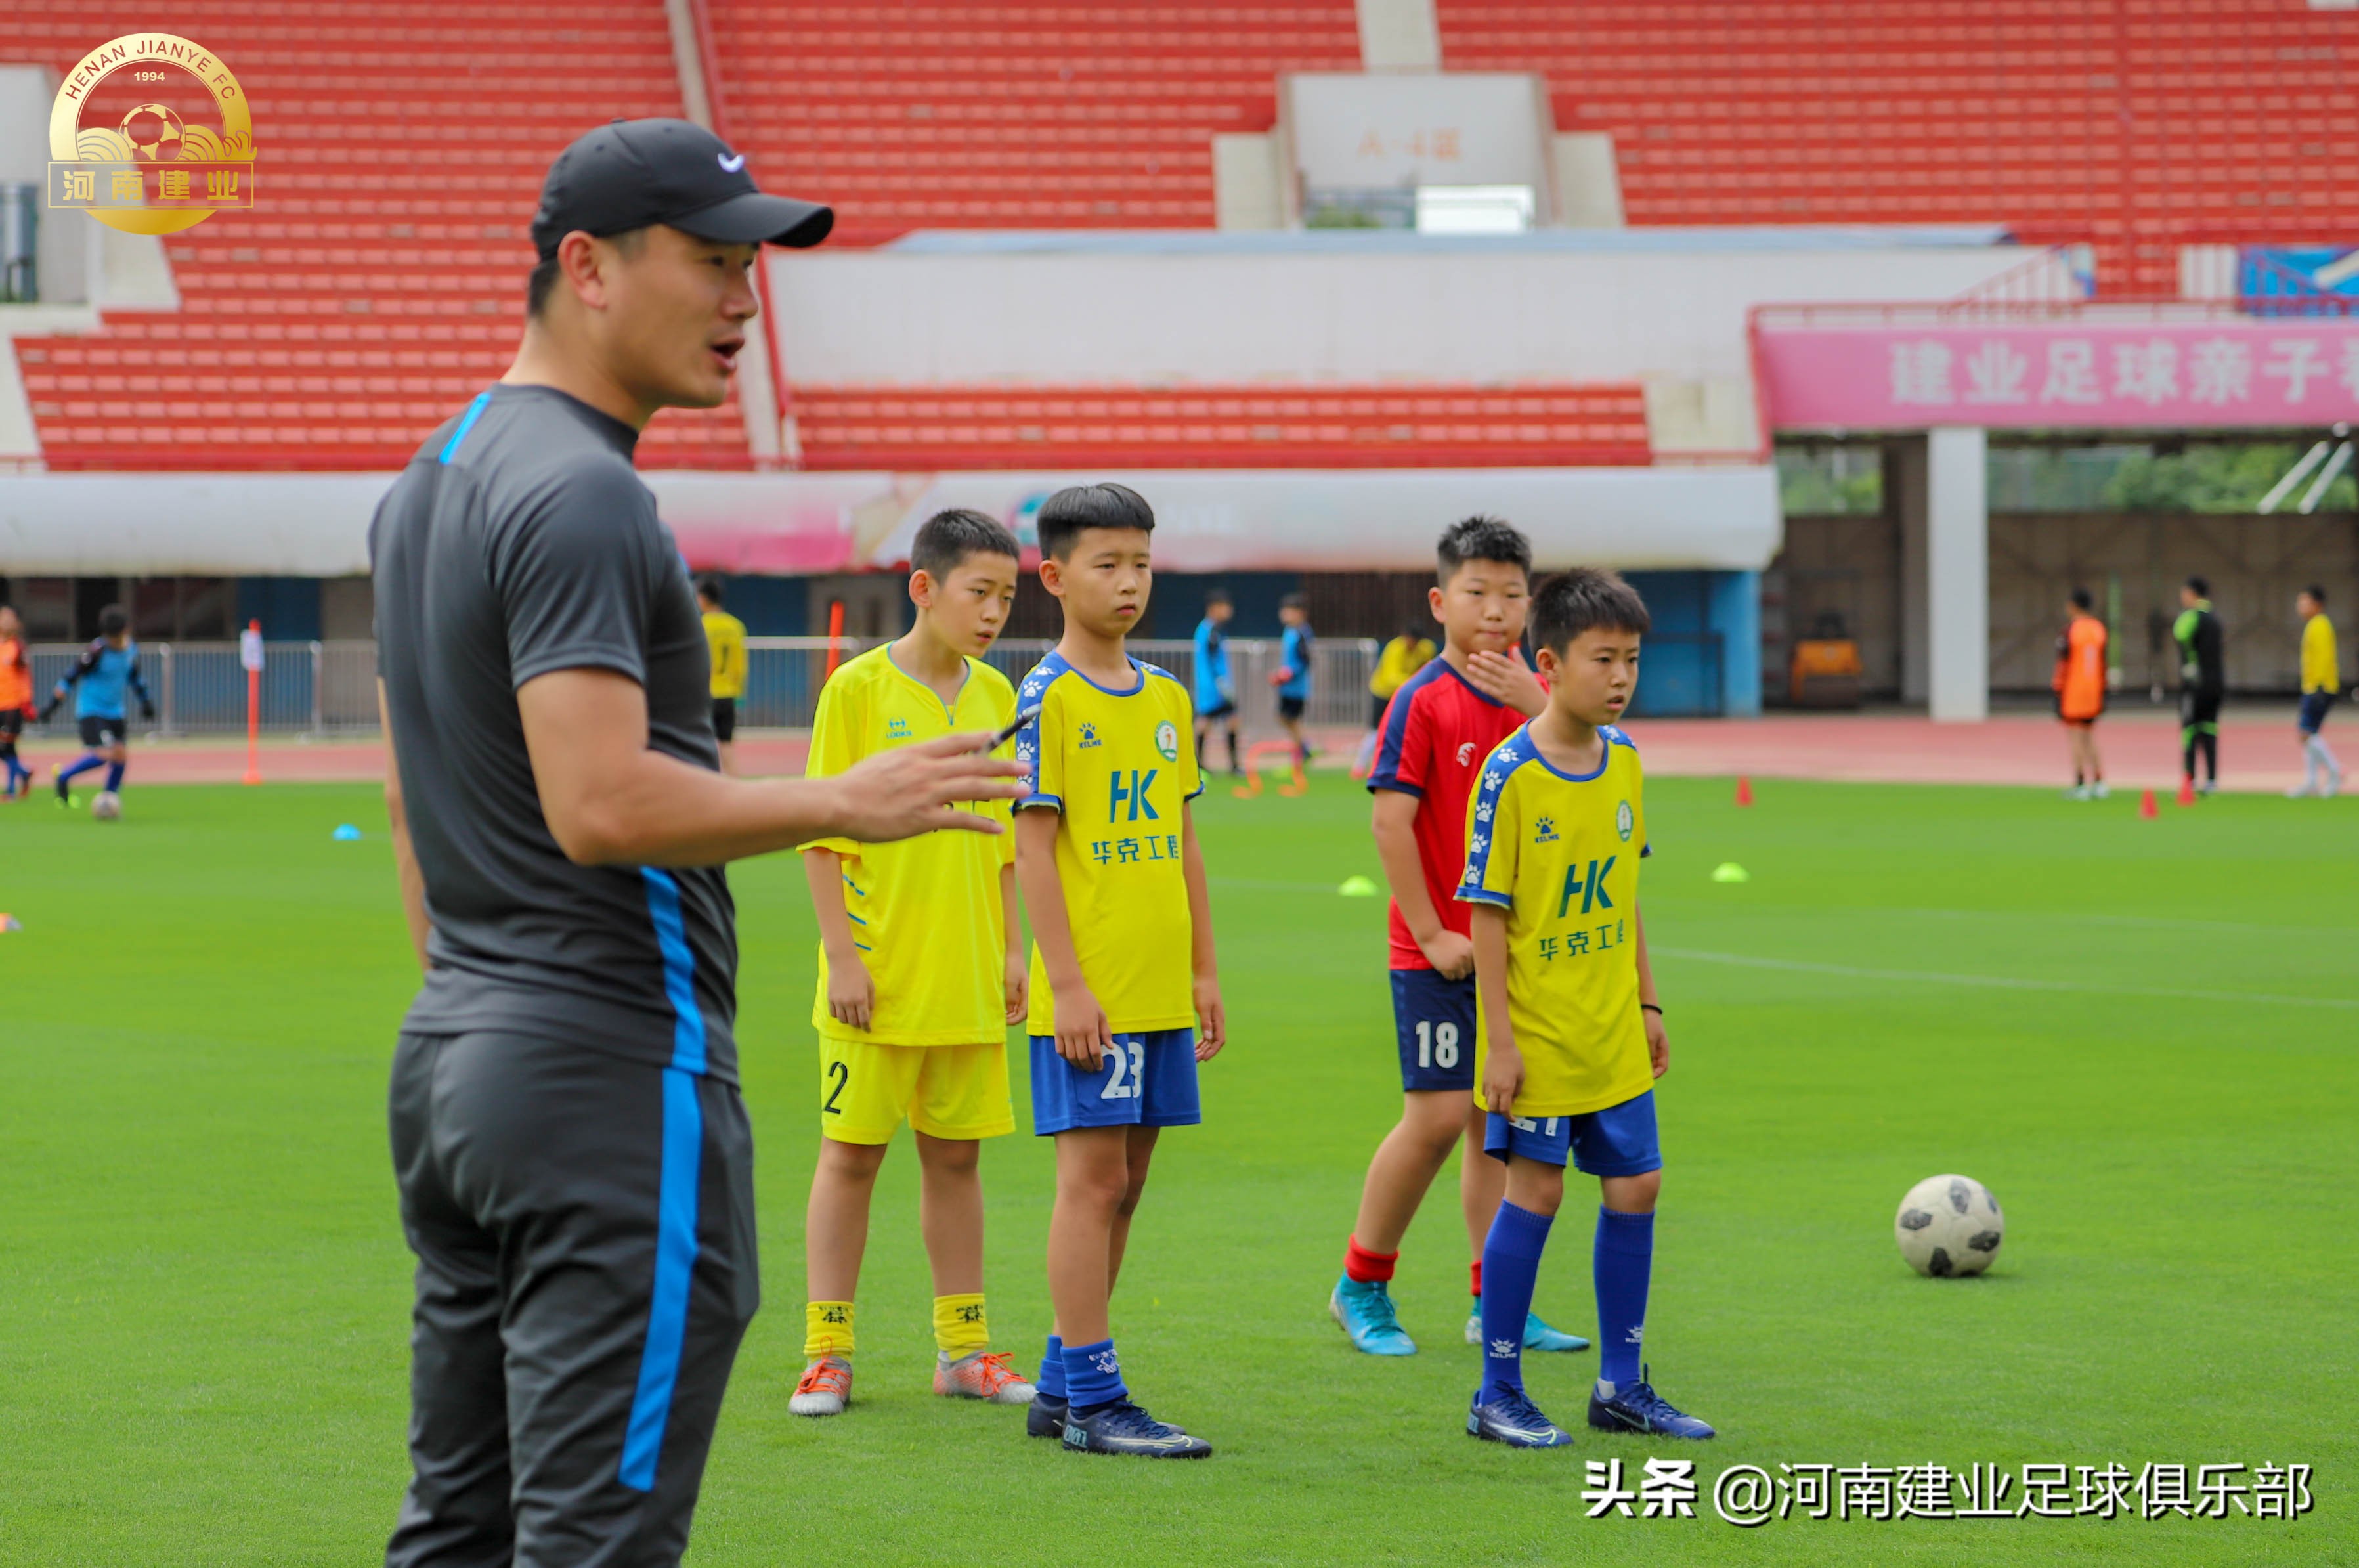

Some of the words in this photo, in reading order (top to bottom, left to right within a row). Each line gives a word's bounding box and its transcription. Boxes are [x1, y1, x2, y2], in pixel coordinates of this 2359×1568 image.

[1110, 769, 1159, 823] HK
[1557, 856, 1617, 919] HK
[1100, 1041, 1144, 1100] 23
[1416, 1020, 1459, 1069] 18
[823, 1061, 848, 1114] 2
